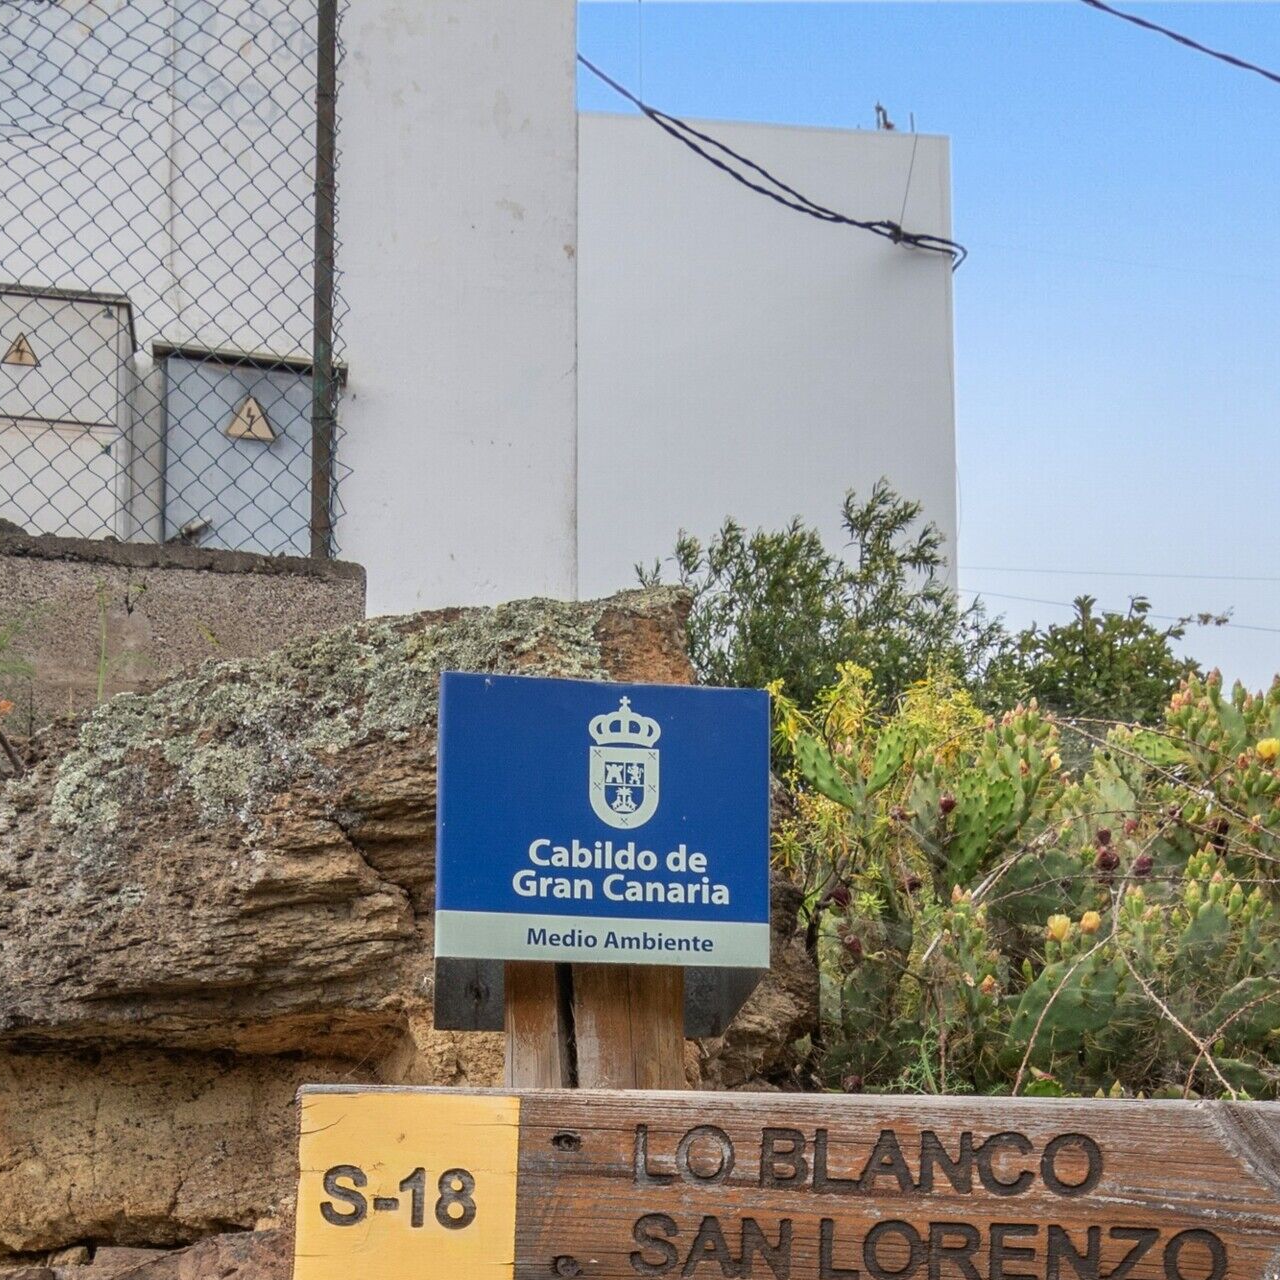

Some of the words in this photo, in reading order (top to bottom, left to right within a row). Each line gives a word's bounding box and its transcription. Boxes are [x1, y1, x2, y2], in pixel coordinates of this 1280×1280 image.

[528, 839, 658, 873] Cabildo
[666, 844, 708, 874] de
[512, 870, 593, 900] Gran
[602, 874, 730, 905] Canaria
[527, 928, 598, 949] Medio
[604, 932, 715, 952] Ambiente
[633, 1124, 735, 1186] LO
[760, 1126, 1104, 1197] BLANCO
[320, 1164, 477, 1231] S-18
